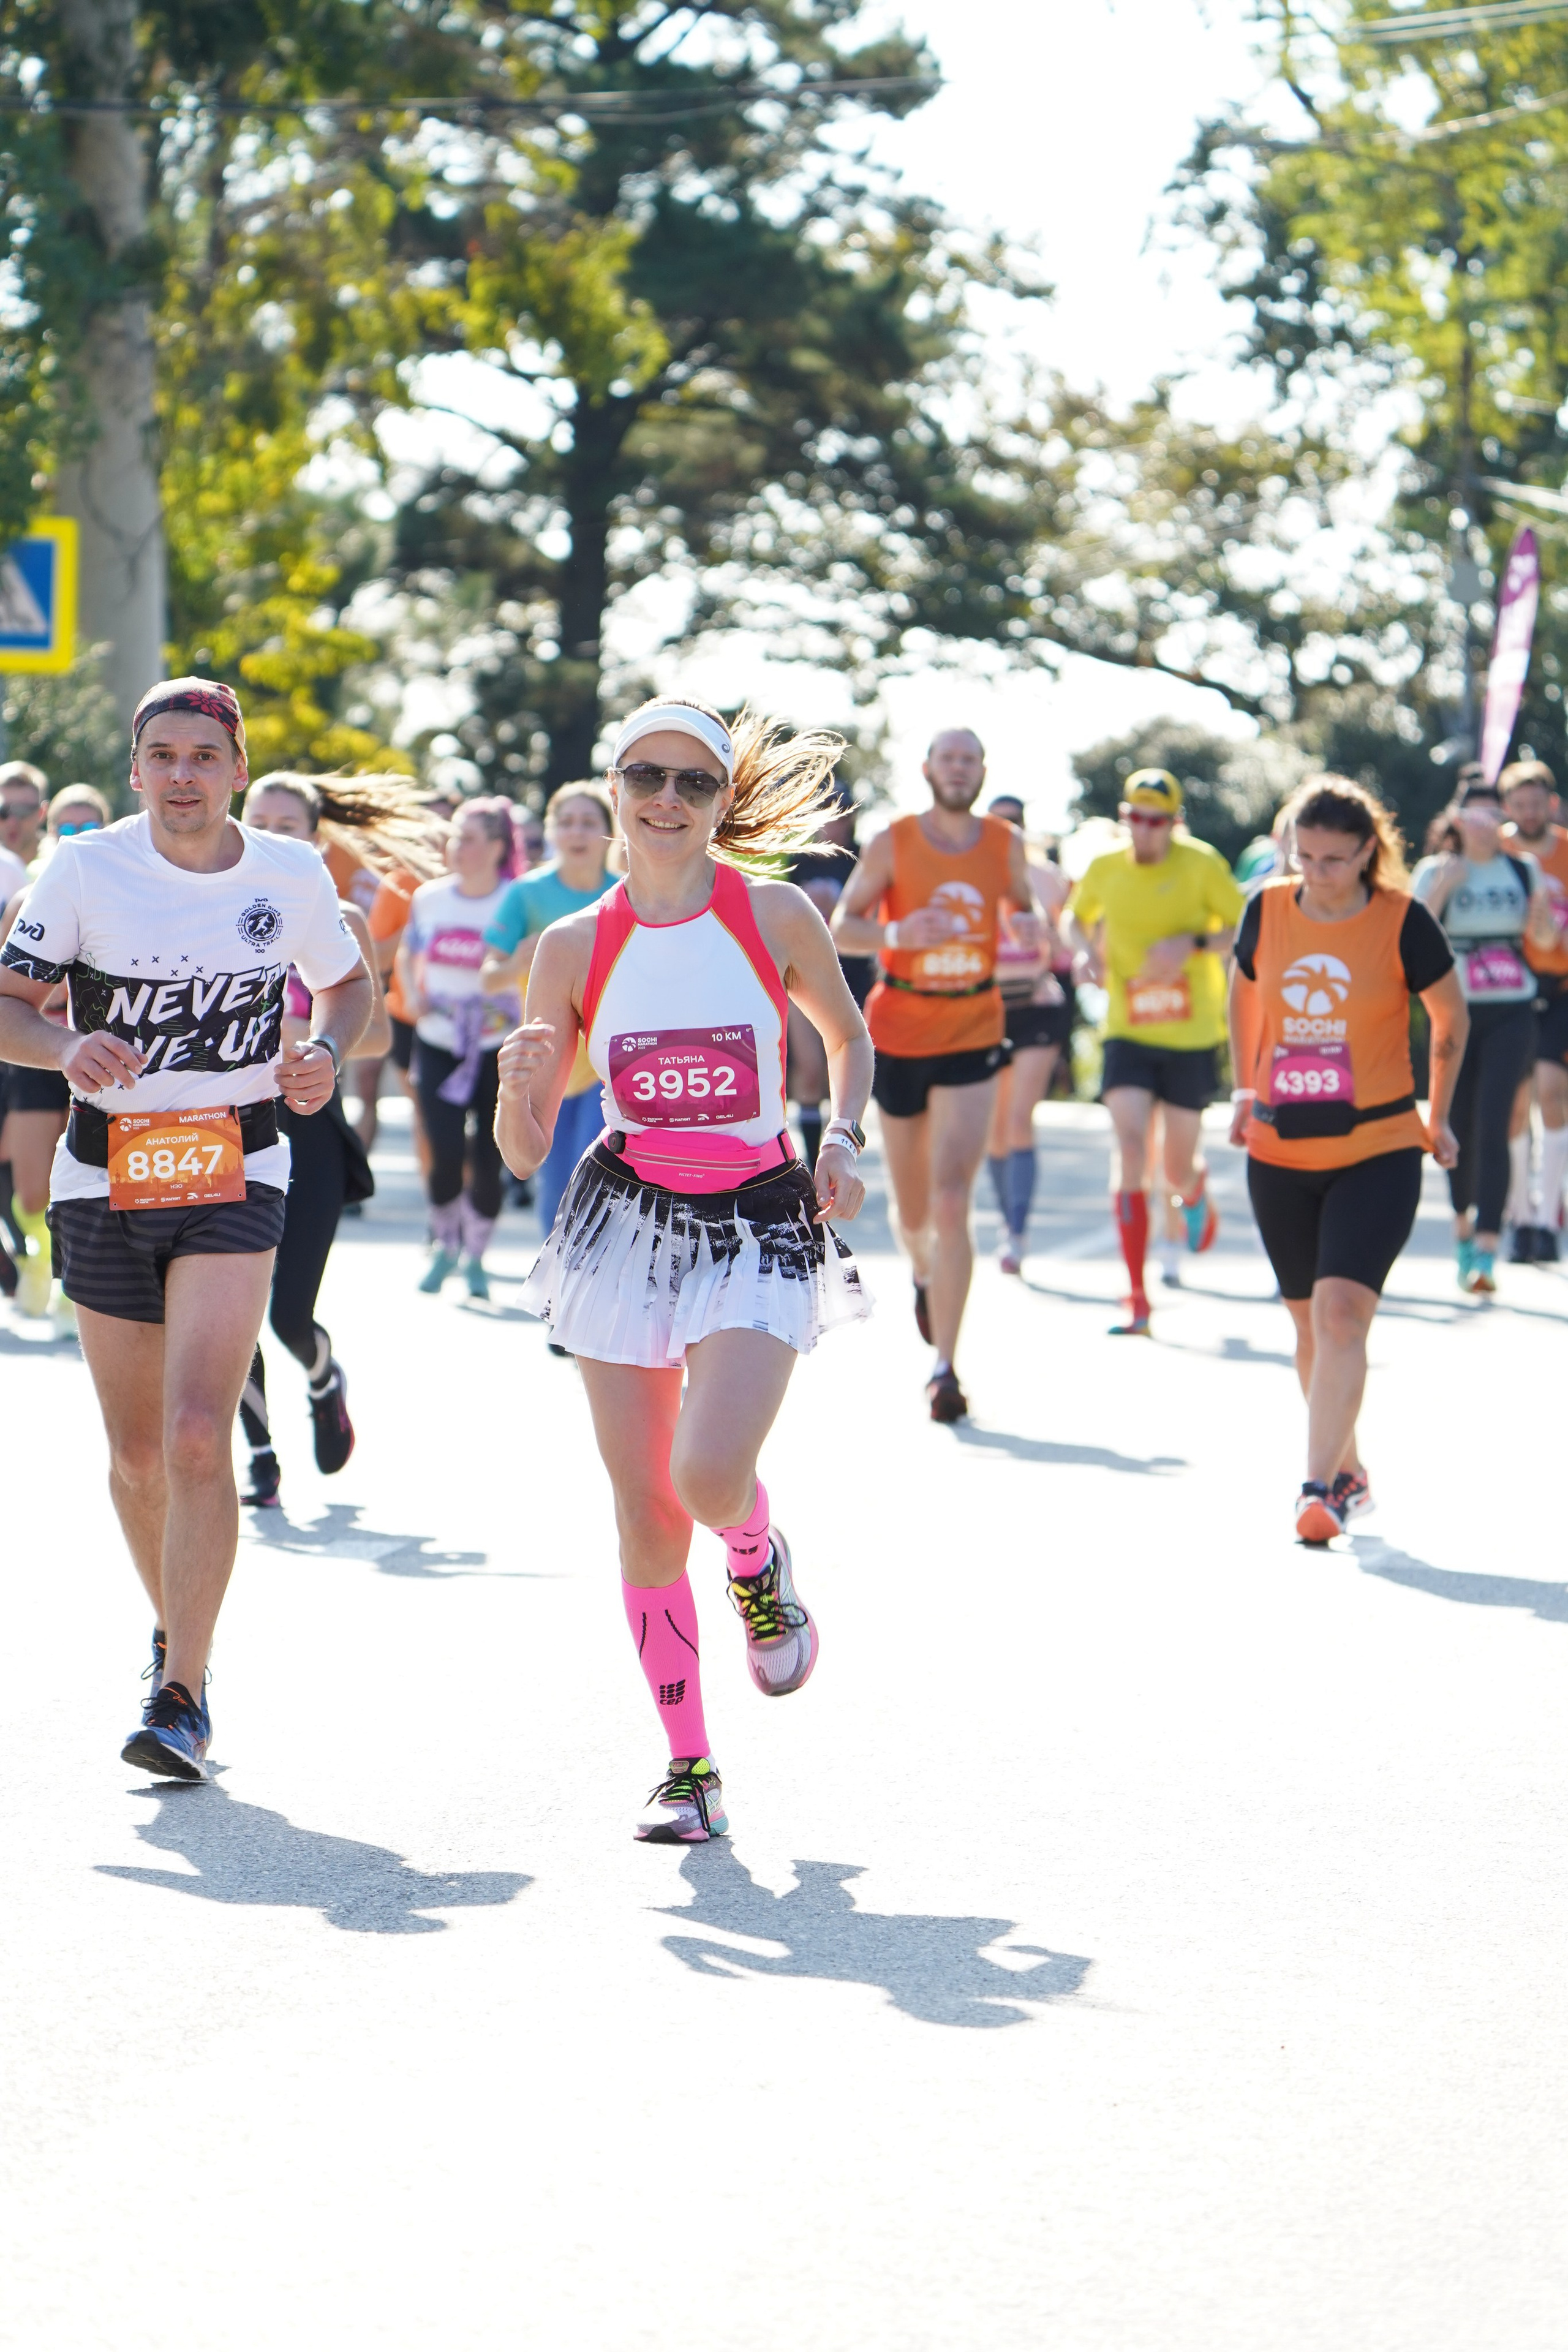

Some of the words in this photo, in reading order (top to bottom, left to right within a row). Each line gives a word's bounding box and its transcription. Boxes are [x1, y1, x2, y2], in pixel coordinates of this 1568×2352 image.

[241, 903, 266, 917] GOLDEN
[241, 935, 260, 948] ULTRA
[105, 964, 281, 1027] NEVER
[1281, 1016, 1348, 1036] SOCHI
[725, 1031, 742, 1041] KM
[658, 1055, 705, 1065] ТАТЬЯНА
[631, 1066, 737, 1101] 3952
[1274, 1068, 1341, 1096] 4393
[179, 1112, 227, 1123] MARATHON
[146, 1133, 198, 1145] АНАТОЛИЙ
[127, 1144, 223, 1181] 8847
[660, 1695, 684, 1705] cep
